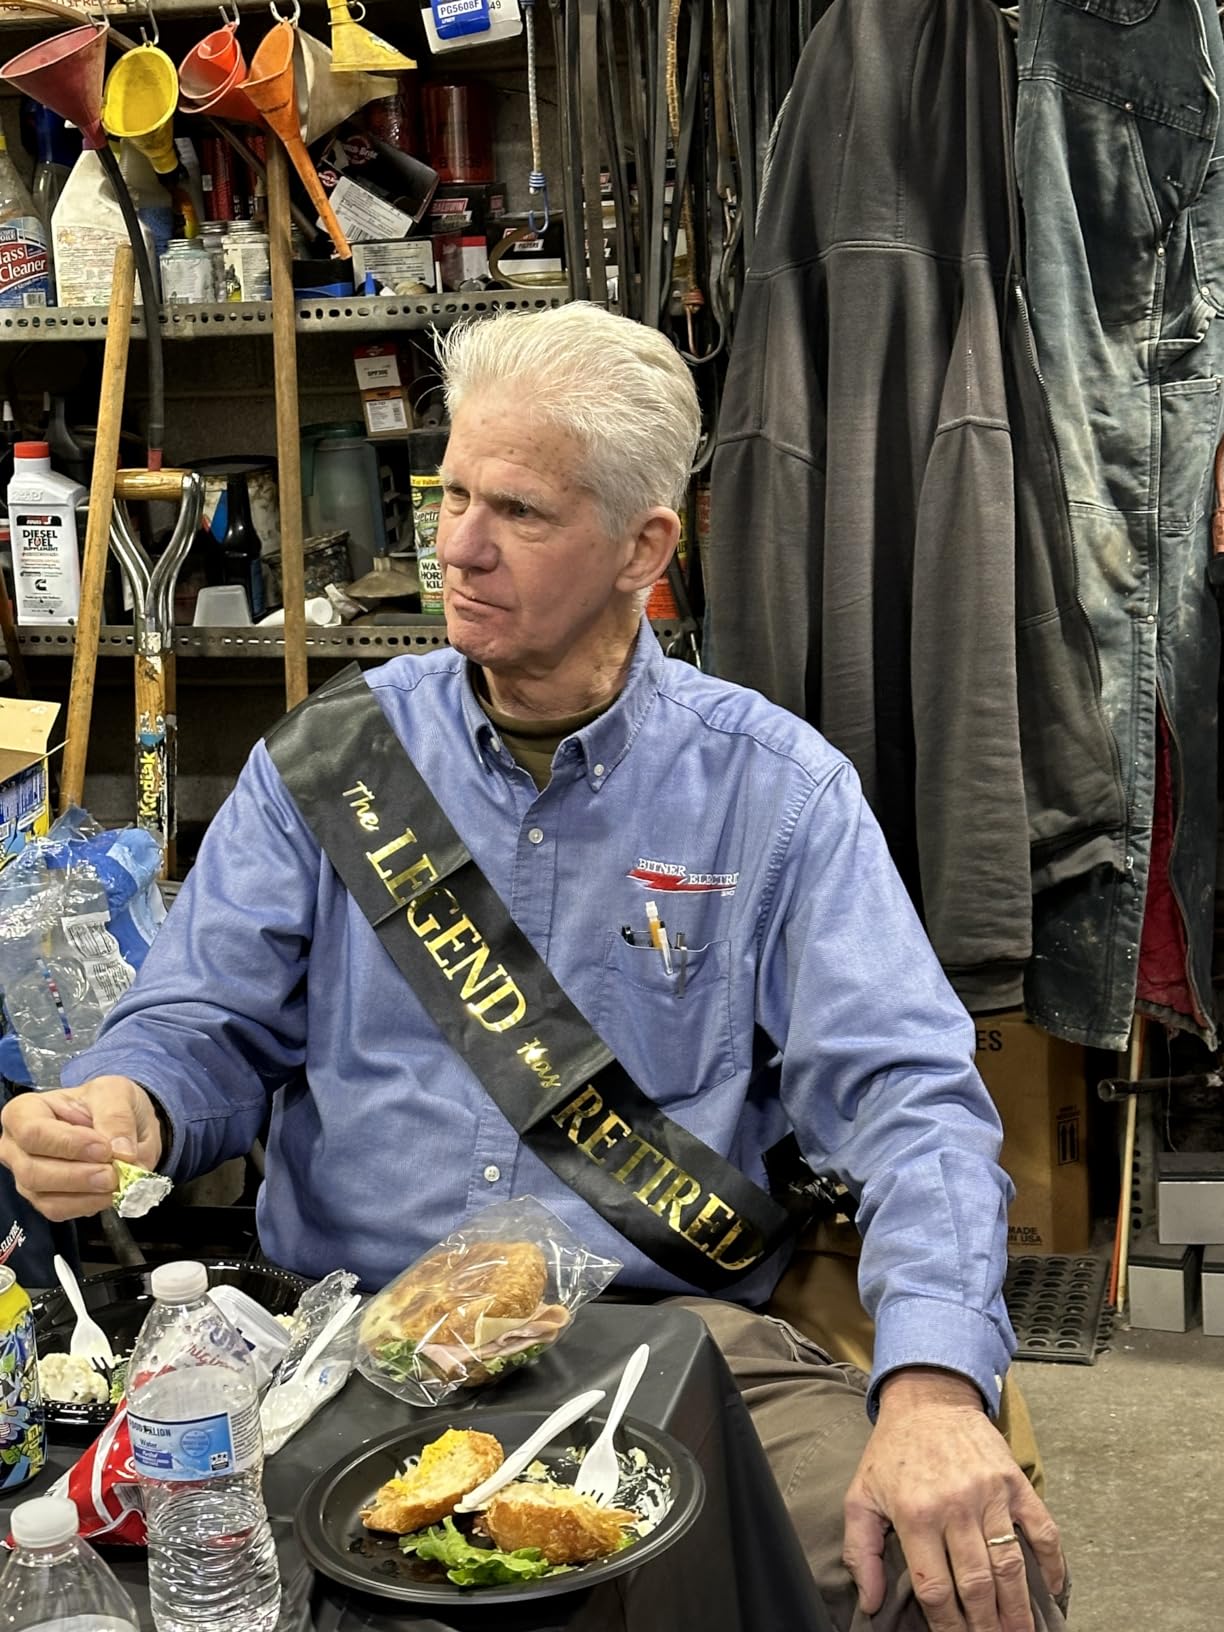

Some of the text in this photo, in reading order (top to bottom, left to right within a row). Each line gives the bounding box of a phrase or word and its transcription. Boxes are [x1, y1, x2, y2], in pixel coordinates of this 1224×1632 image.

[440, 1, 480, 15] PG5608F
[0, 260, 46, 282] Cleaner
[22, 529, 58, 539] DIESEL
[28, 538, 53, 547] FUEL
[140, 750, 159, 816] Kodiak
[637, 857, 687, 877] BITNER
[688, 872, 740, 886] ELECTRI
[341, 780, 766, 1272] The LEGEND Has RETIRED
[1008, 1226, 1039, 1235] MADE
[1020, 1234, 1042, 1244] USA
[152, 1427, 171, 1437] LION
[139, 1438, 158, 1448] Water
